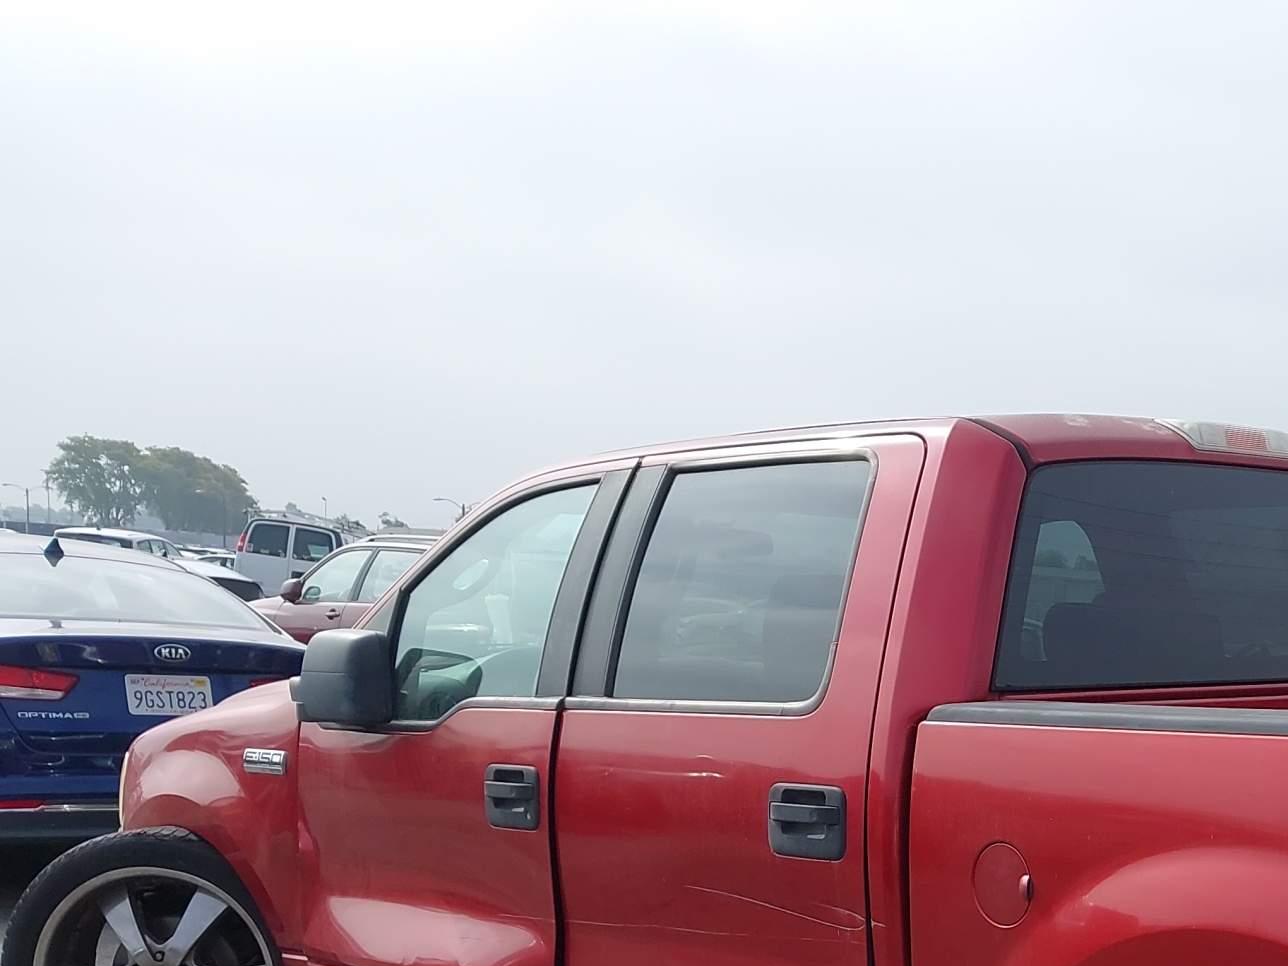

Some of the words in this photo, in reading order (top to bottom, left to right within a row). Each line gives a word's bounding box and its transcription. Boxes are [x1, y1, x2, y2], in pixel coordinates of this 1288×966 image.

[160, 647, 186, 659] KIA
[143, 679, 190, 690] California
[133, 689, 207, 710] 9GST823
[17, 711, 73, 719] OPTIMA
